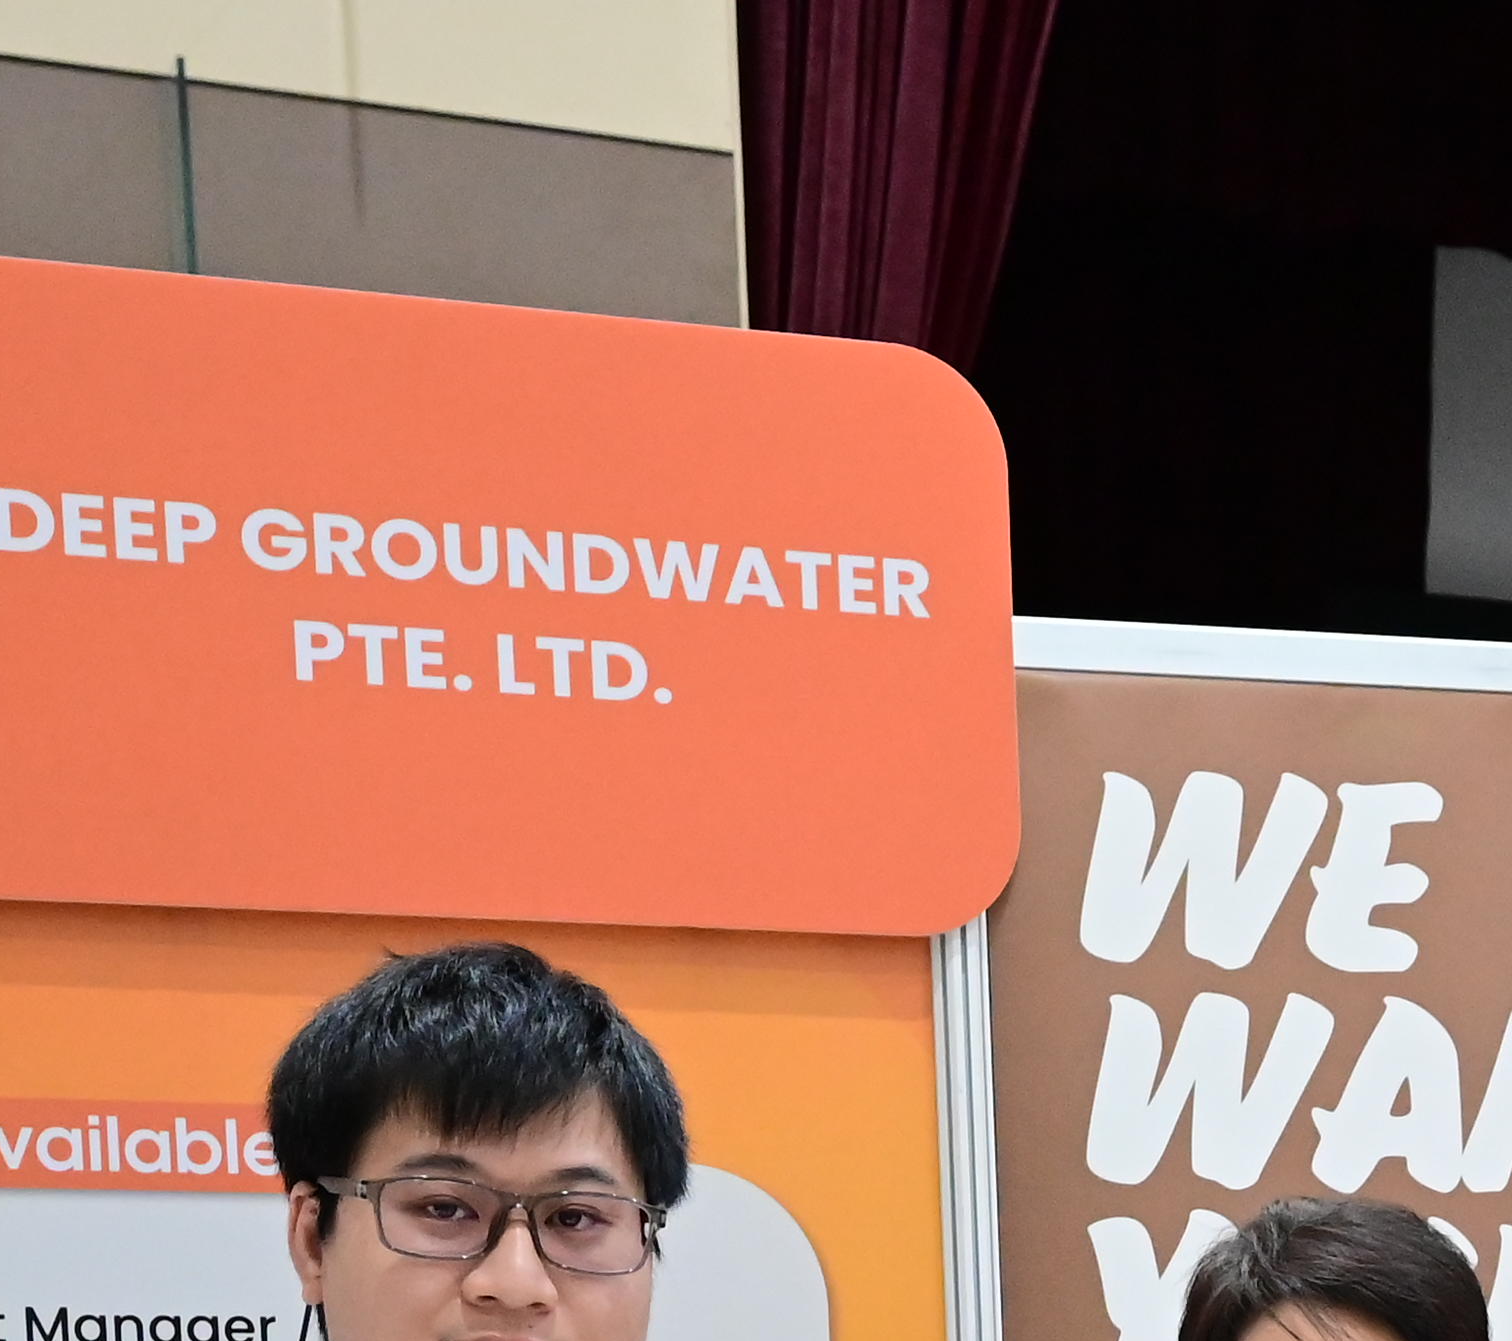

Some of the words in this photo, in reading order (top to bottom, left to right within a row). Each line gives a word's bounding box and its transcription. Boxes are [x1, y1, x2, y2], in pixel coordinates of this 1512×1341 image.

[240, 507, 931, 619] GROUNDWATER
[292, 619, 473, 692] PTE.
[496, 633, 673, 705] LTD.
[1080, 769, 1444, 972] WE
